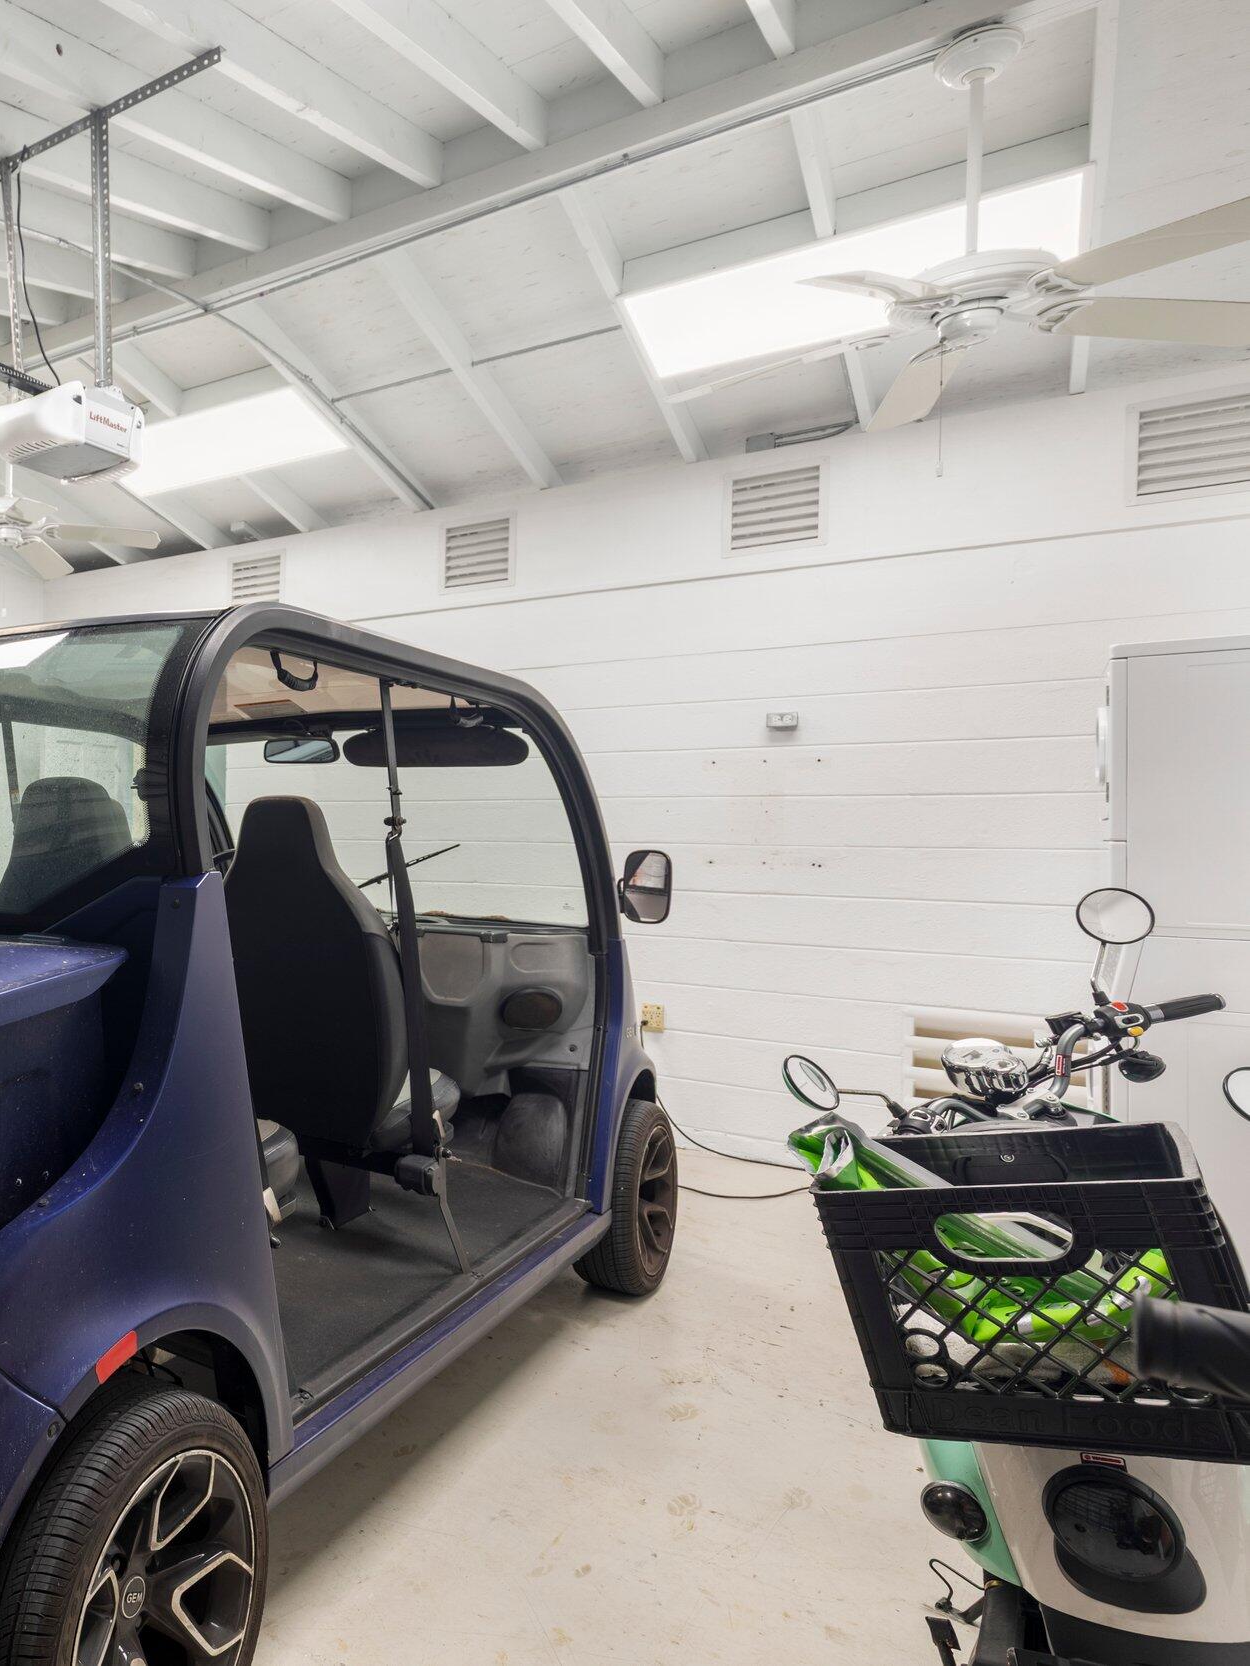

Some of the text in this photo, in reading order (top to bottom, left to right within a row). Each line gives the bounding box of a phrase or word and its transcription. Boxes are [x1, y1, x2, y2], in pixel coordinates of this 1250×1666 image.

[90, 411, 127, 433] LiftMaster
[930, 1397, 1224, 1446] Dean Foods
[127, 1592, 143, 1604] GEM
